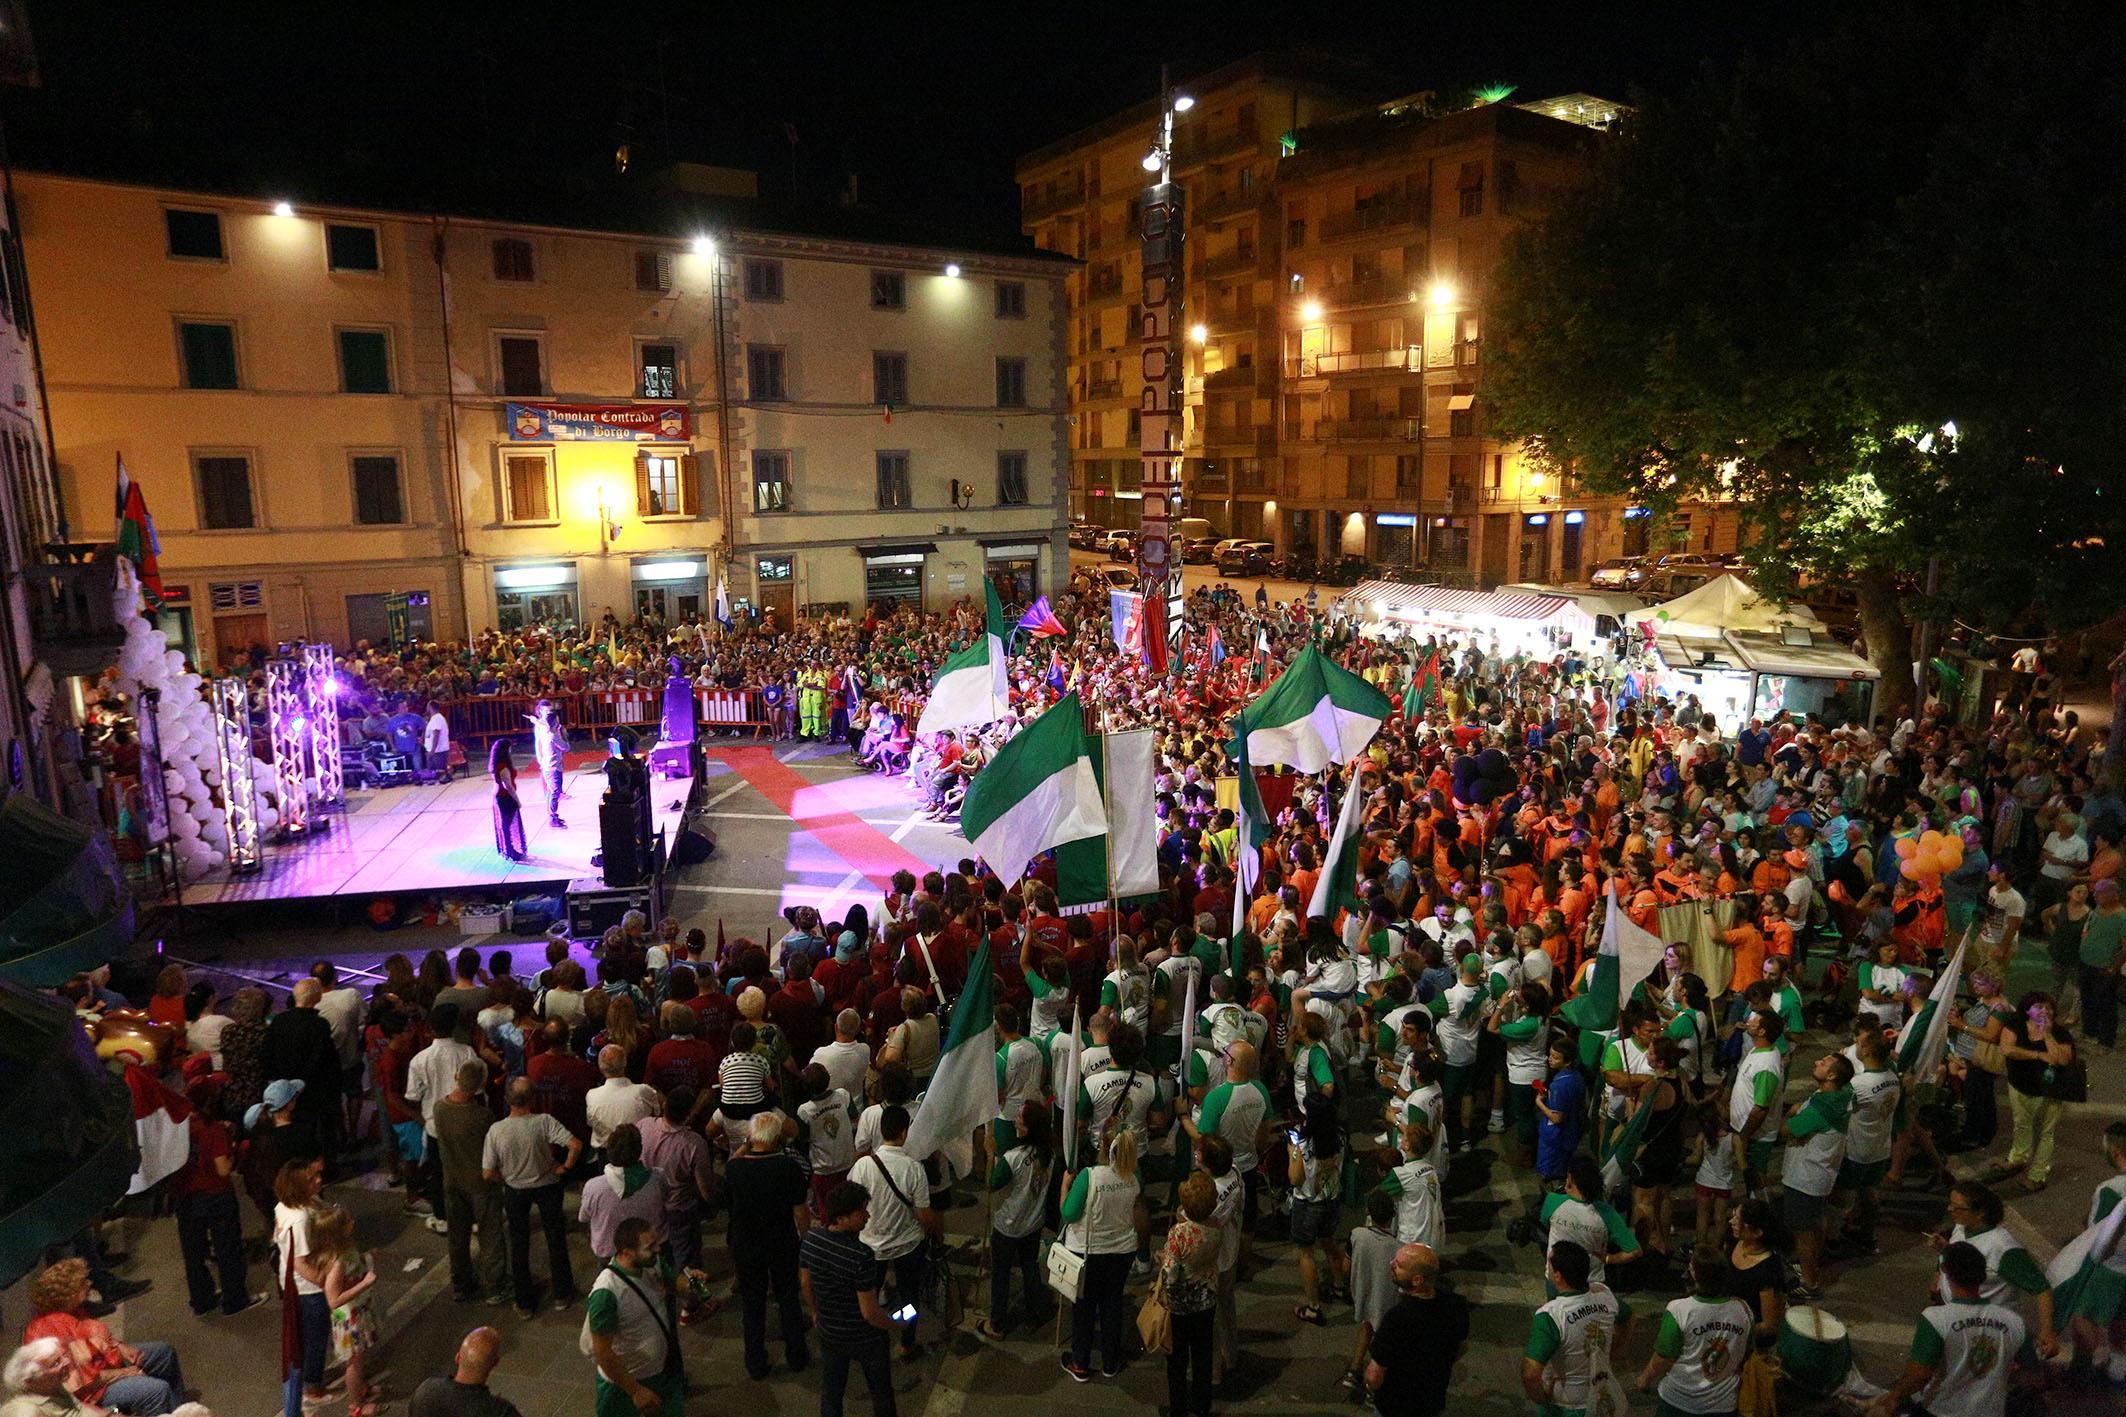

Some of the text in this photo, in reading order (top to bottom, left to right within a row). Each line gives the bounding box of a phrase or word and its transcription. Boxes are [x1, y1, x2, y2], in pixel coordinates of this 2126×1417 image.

[1140, 202, 1171, 416] POPOLO
[547, 409, 655, 424] Popolar Contrada
[575, 425, 630, 439] di Borgo
[1101, 1079, 1142, 1092] CAMBINO
[1566, 1303, 1609, 1325] CAMBIANO
[1692, 1322, 1744, 1336] CAMBIANO
[1951, 1317, 2009, 1334] CAMBIANO
